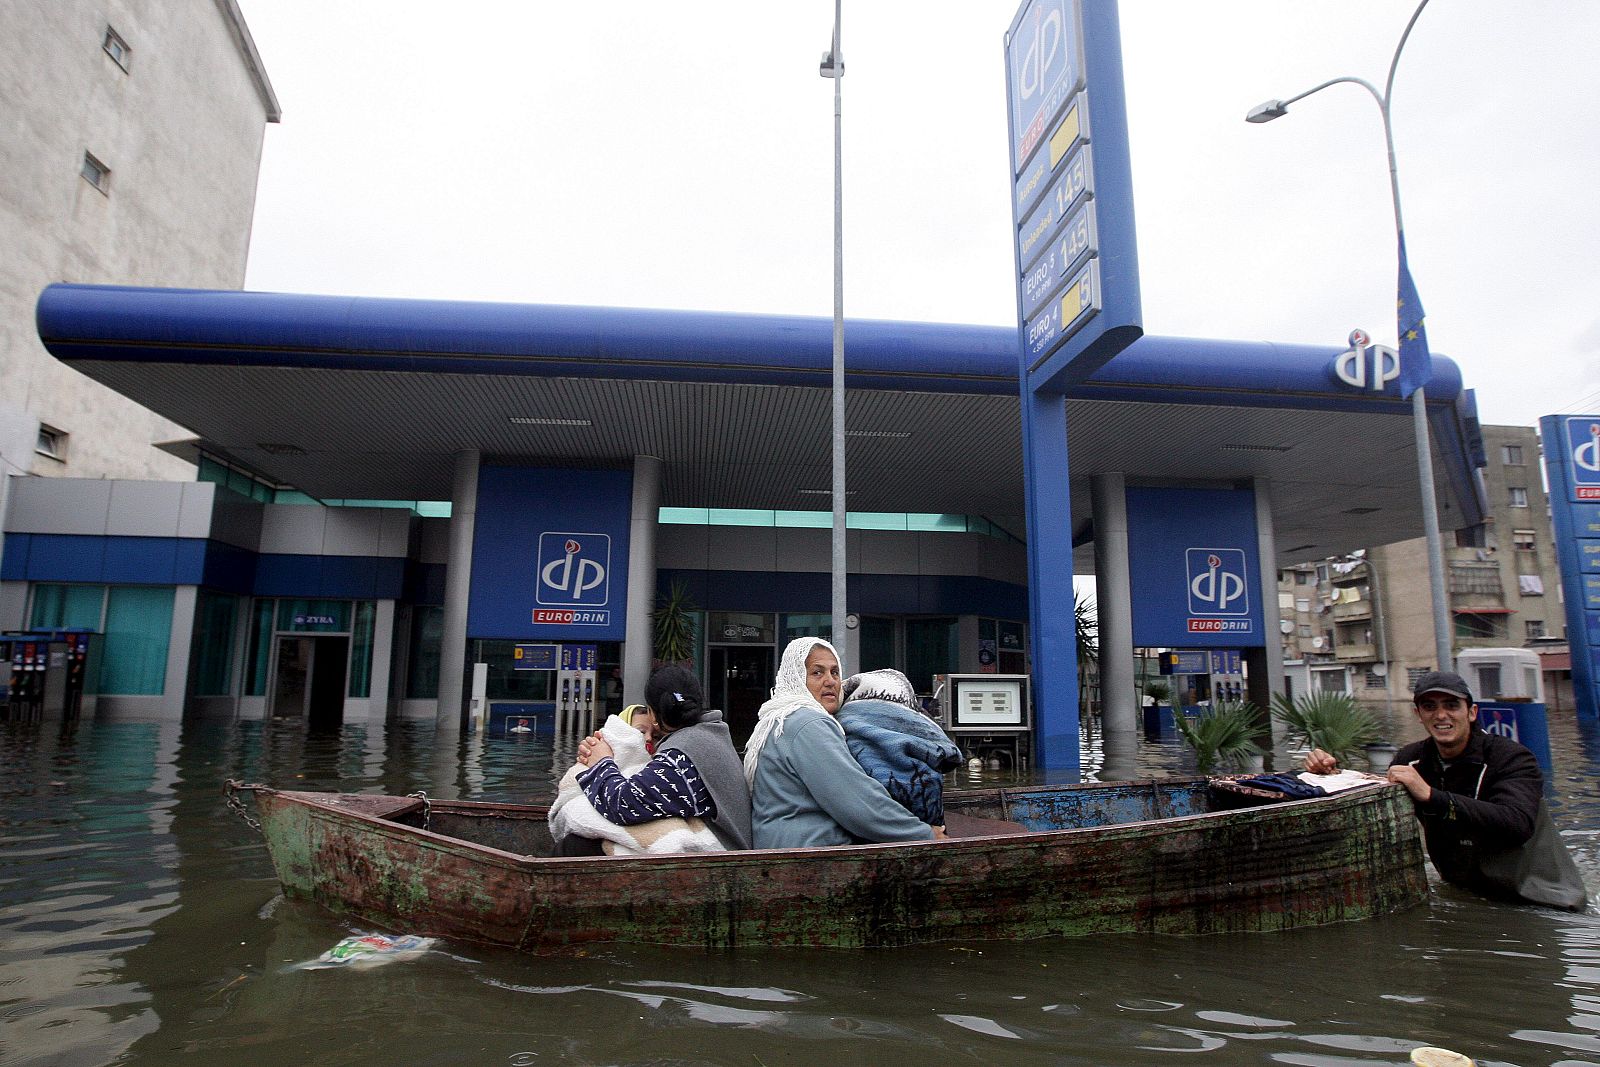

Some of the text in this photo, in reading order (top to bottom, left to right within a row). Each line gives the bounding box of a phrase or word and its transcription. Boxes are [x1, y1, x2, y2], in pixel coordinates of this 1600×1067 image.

[1020, 80, 1070, 158] EURODRIN
[1056, 161, 1083, 215] 145
[1027, 262, 1048, 295] EURO
[1061, 219, 1087, 268] 145
[1029, 314, 1050, 345] EURO
[1052, 305, 1058, 320] 4
[306, 616, 333, 624] ZYRA
[537, 612, 606, 623] EURODRIN
[1191, 620, 1249, 631] EURODRIN
